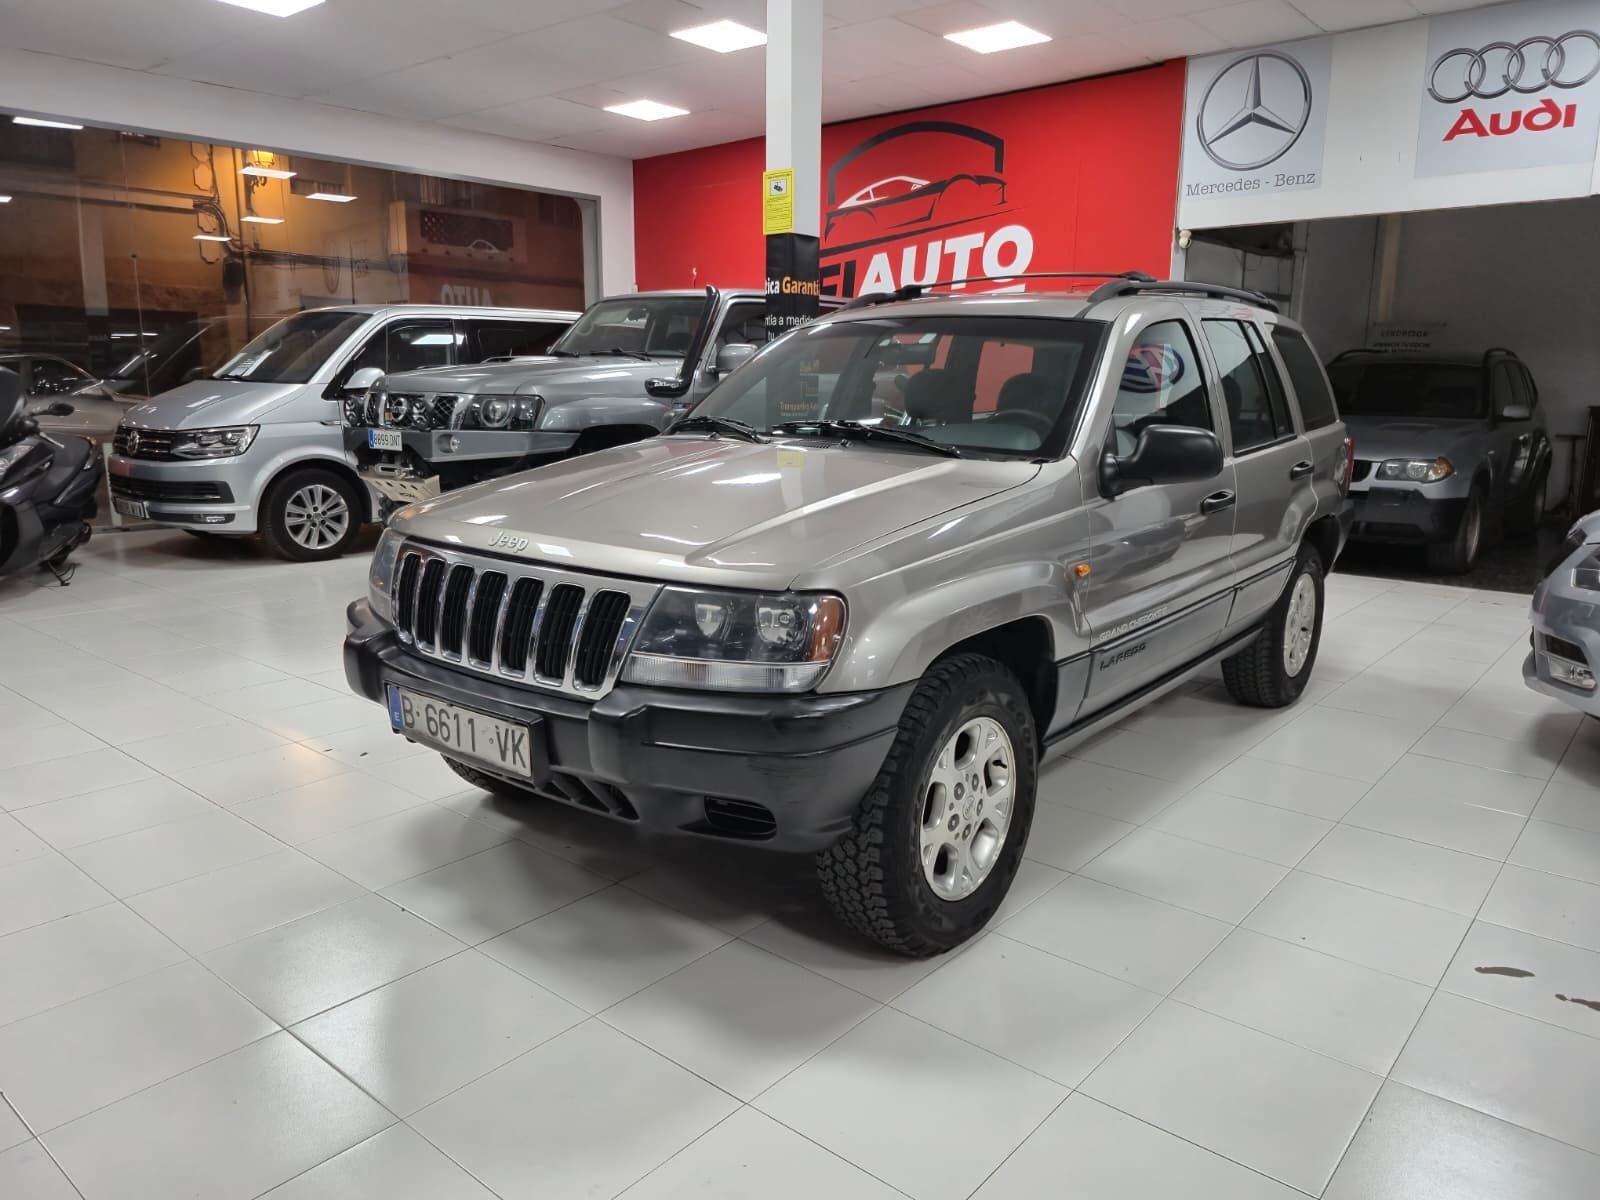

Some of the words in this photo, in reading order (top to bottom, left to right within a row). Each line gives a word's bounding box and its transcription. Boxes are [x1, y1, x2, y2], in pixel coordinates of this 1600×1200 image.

[1442, 98, 1577, 142] Audi
[1185, 178, 1261, 197] Mercedes
[1274, 172, 1316, 188] Benz
[858, 224, 1034, 297] AUTO
[488, 529, 529, 554] Jeep
